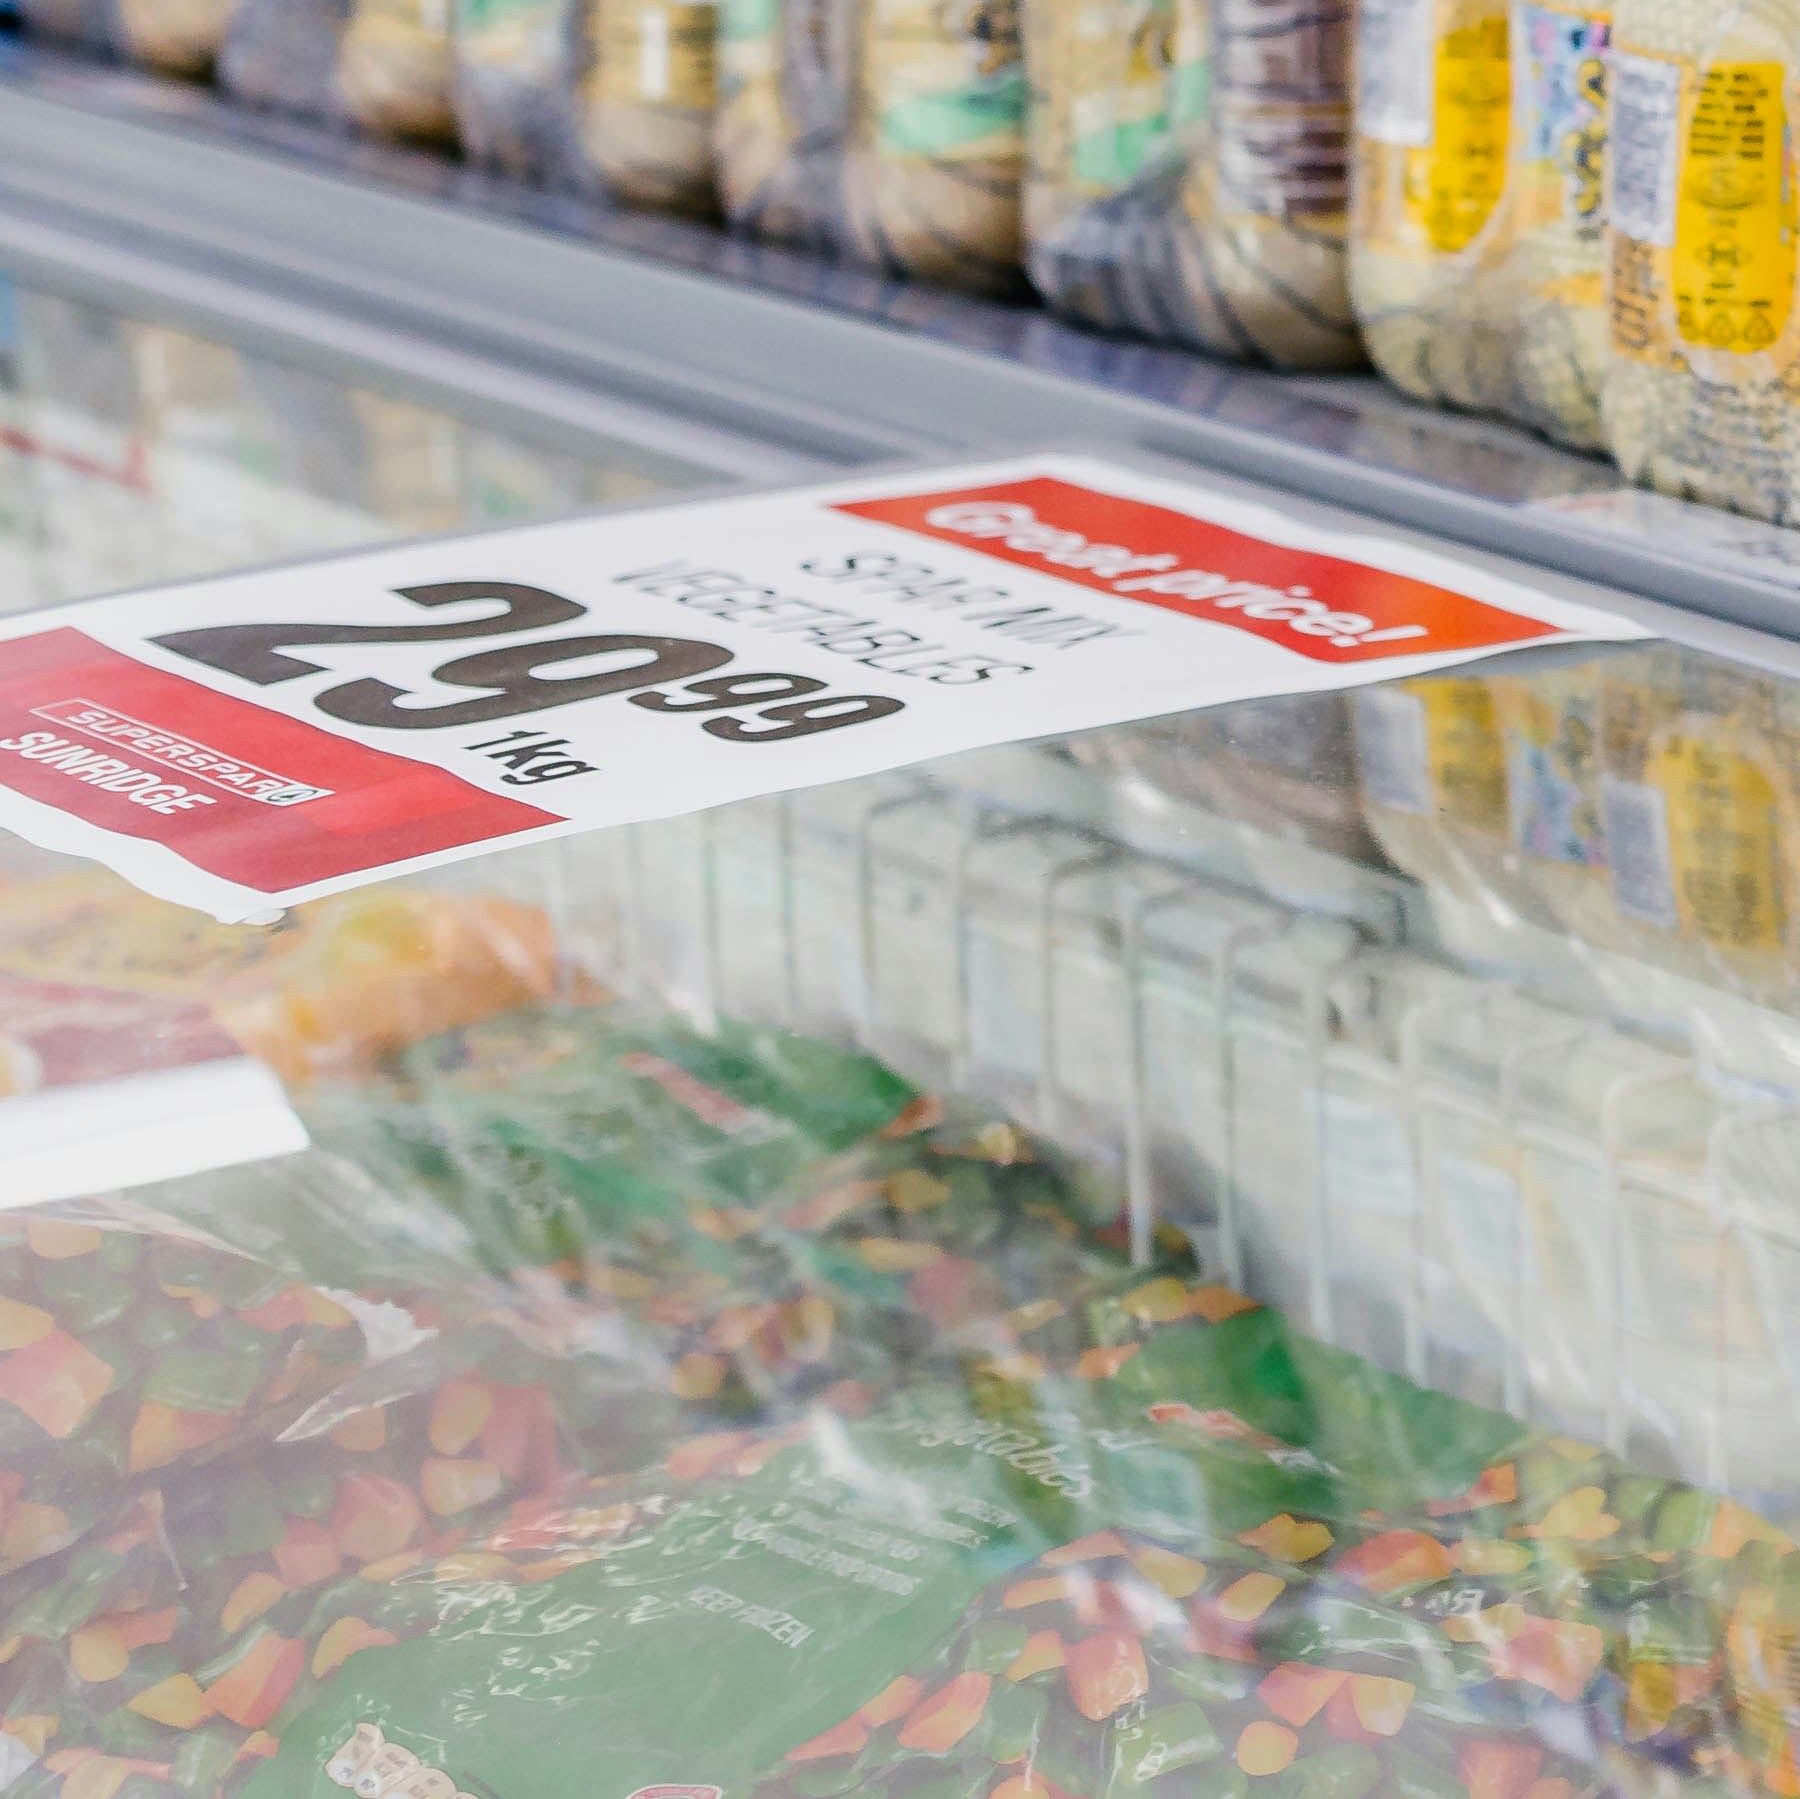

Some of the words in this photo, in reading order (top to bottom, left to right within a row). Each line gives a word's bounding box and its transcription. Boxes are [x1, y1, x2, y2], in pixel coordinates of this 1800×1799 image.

[800, 550, 1012, 614] SPAR
[975, 602, 1145, 652] MIX
[925, 500, 1178, 580] Great
[1113, 557, 1430, 647] price!
[612, 559, 1037, 687] VEGETABLES
[0, 731, 219, 816] SUNRIDGE
[66, 708, 296, 798] SUPERSPAR
[462, 729, 605, 787] 1kg
